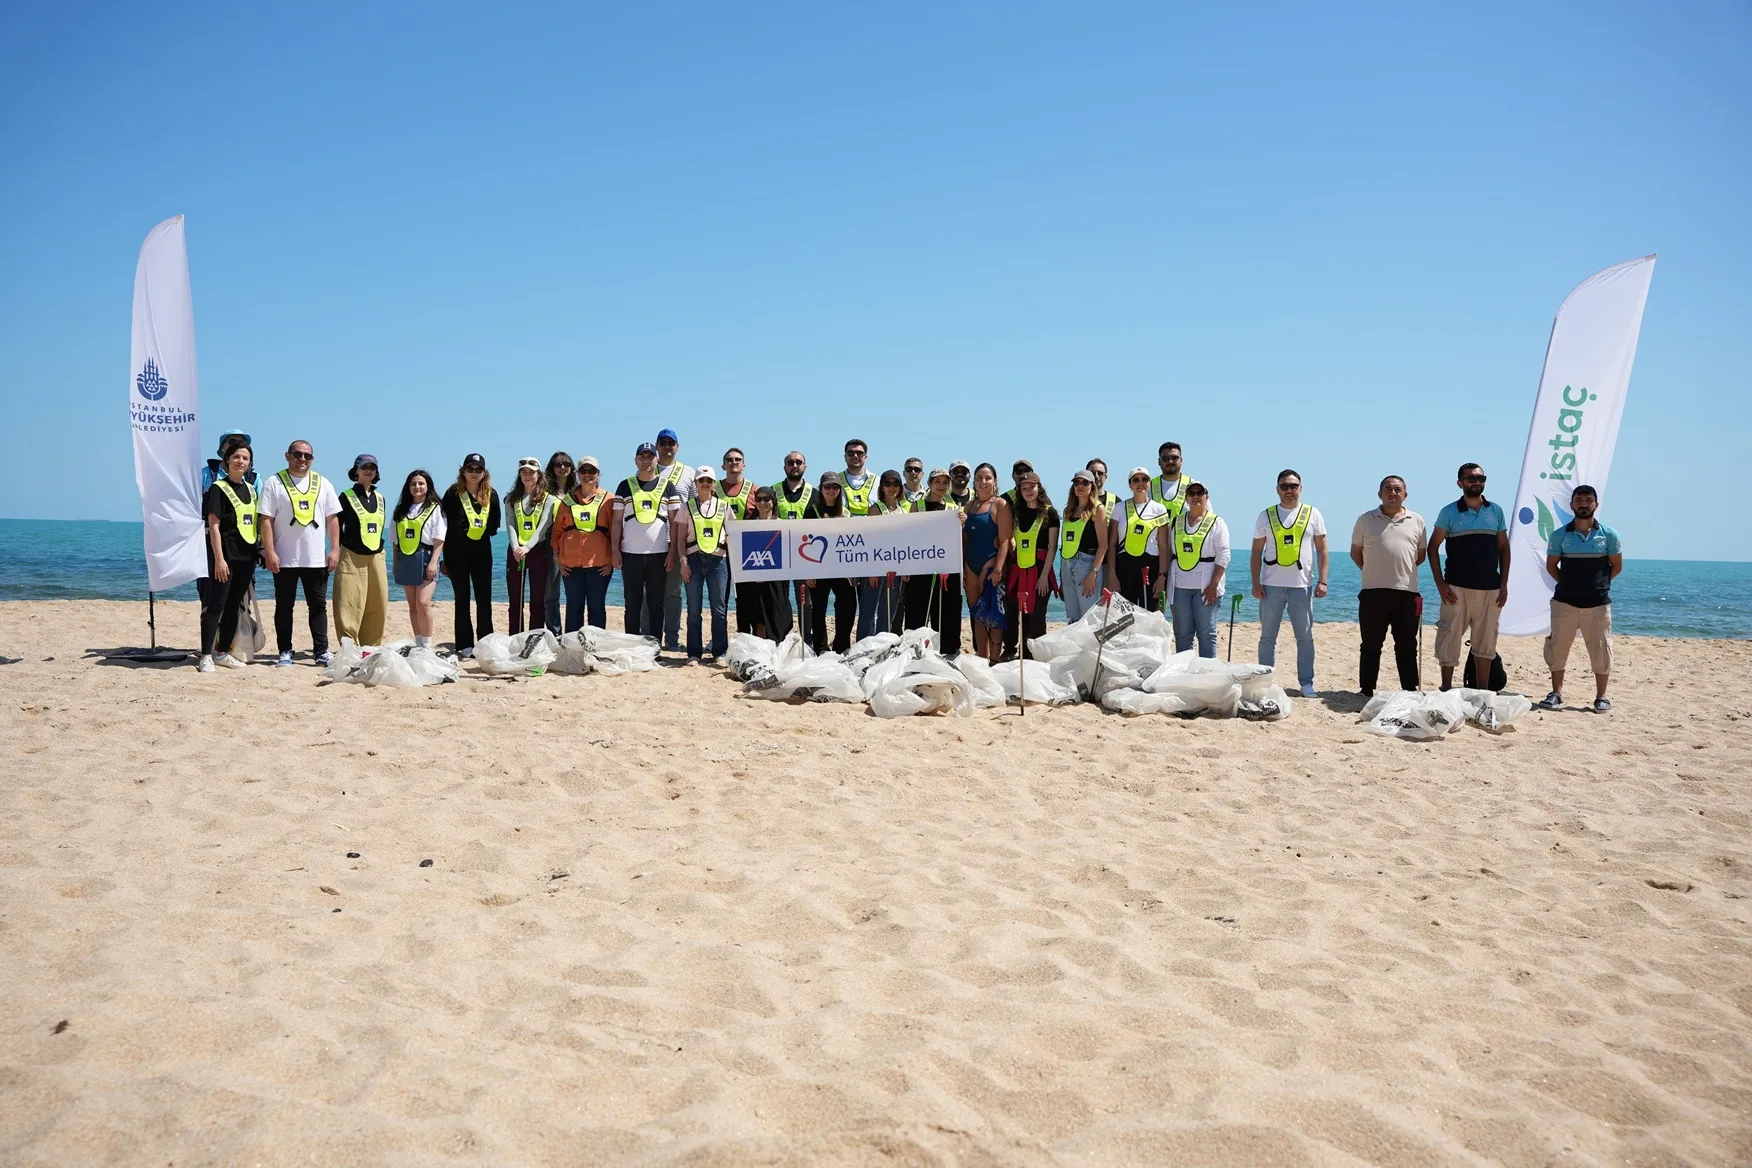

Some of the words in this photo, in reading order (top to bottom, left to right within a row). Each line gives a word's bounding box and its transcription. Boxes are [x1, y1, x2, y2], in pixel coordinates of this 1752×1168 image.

[131, 402, 182, 413] STANBUL
[130, 411, 195, 425] YÜKŞEHİR
[1540, 385, 1597, 480] istaç
[836, 534, 865, 548] AXA
[742, 550, 776, 567] AXA
[836, 549, 869, 564] Tüm
[873, 545, 946, 564] Kalplerde
